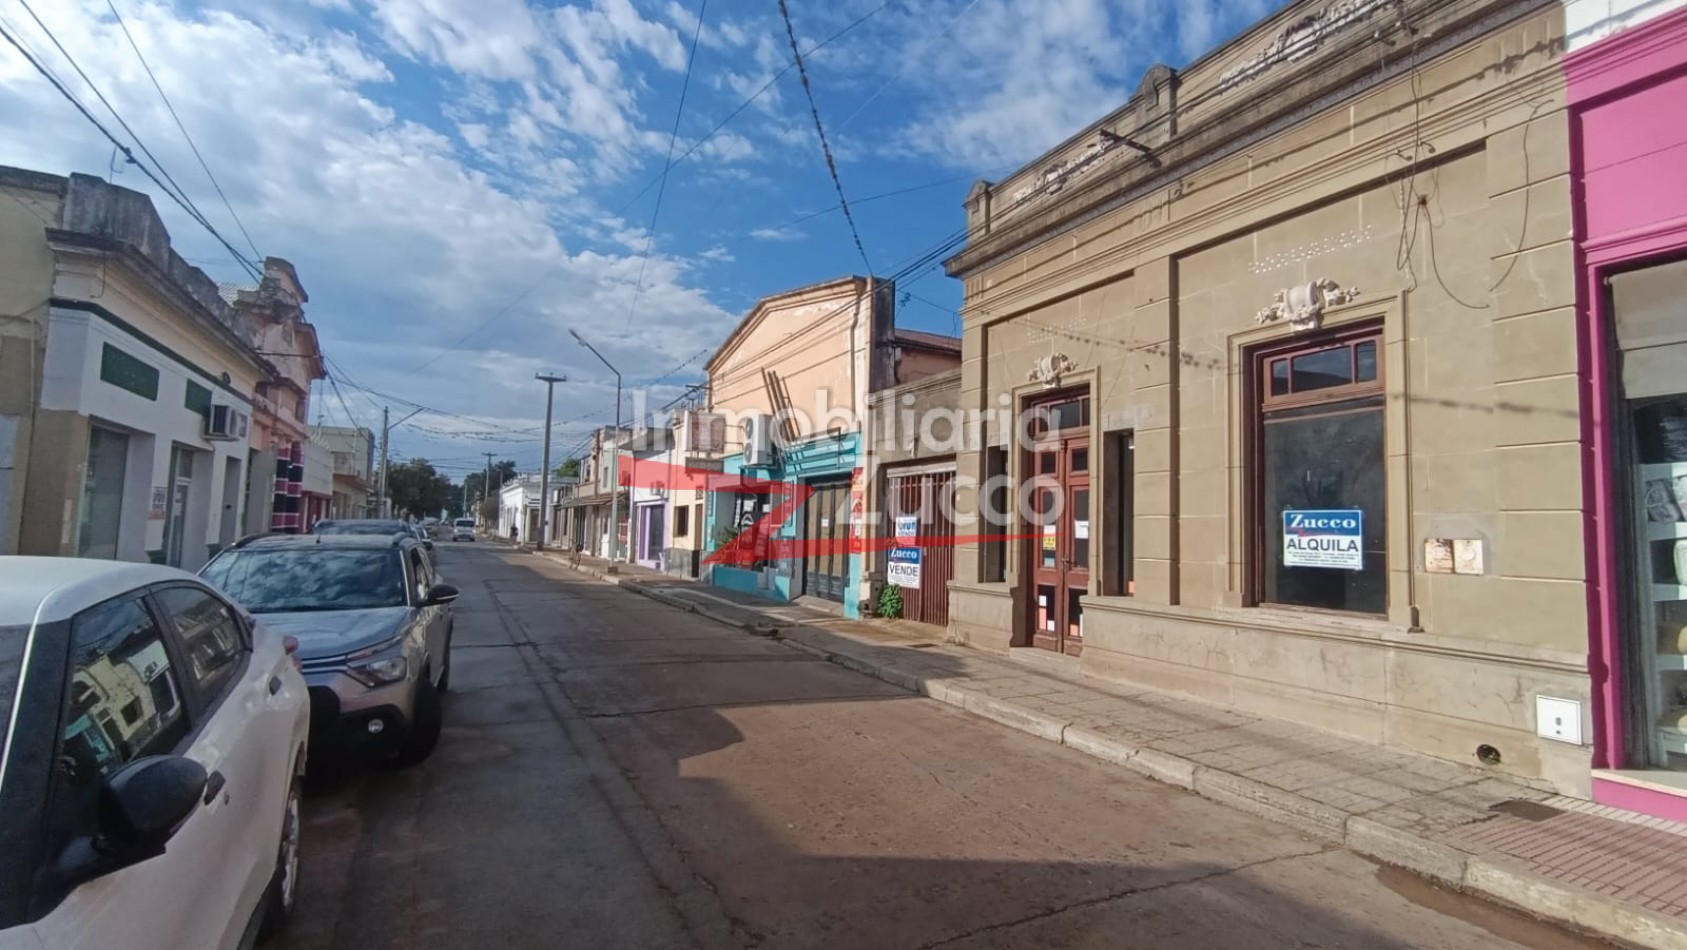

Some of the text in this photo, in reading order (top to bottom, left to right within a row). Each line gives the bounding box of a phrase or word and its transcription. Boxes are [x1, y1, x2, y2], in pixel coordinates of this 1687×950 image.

[1290, 514, 1356, 529] Zucco
[1287, 538, 1359, 552] ALQUILA
[890, 547, 918, 558] Zucco
[889, 565, 918, 577] VENDE
